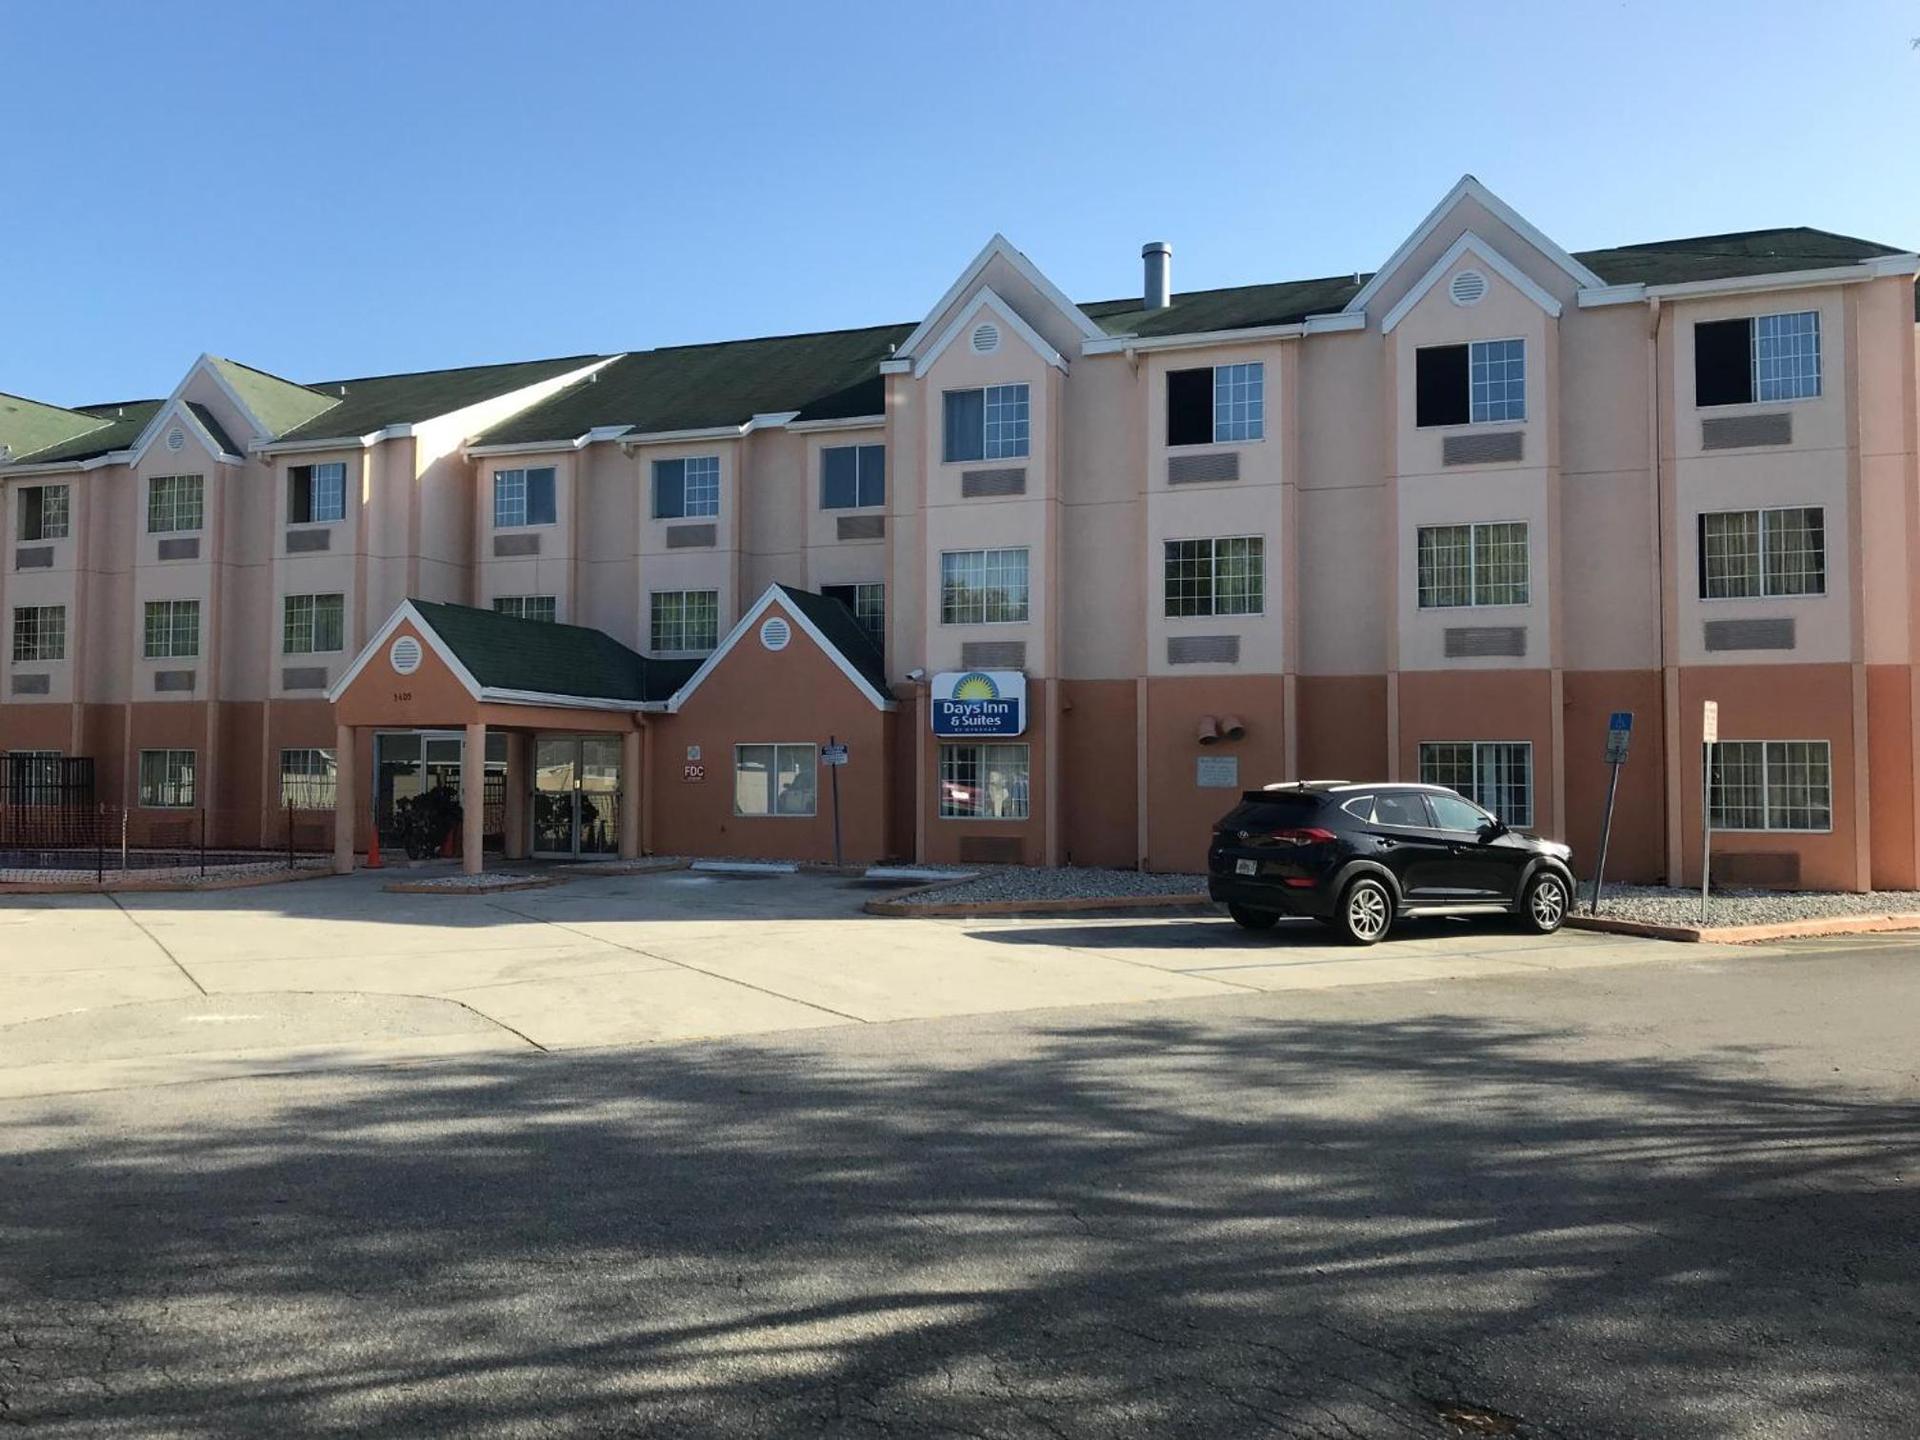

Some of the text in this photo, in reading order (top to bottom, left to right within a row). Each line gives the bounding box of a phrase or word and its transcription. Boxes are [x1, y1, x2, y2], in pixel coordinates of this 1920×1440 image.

[943, 702, 1009, 715] Days Inn
[950, 714, 1002, 726] & Suites
[684, 766, 704, 777] FDC
